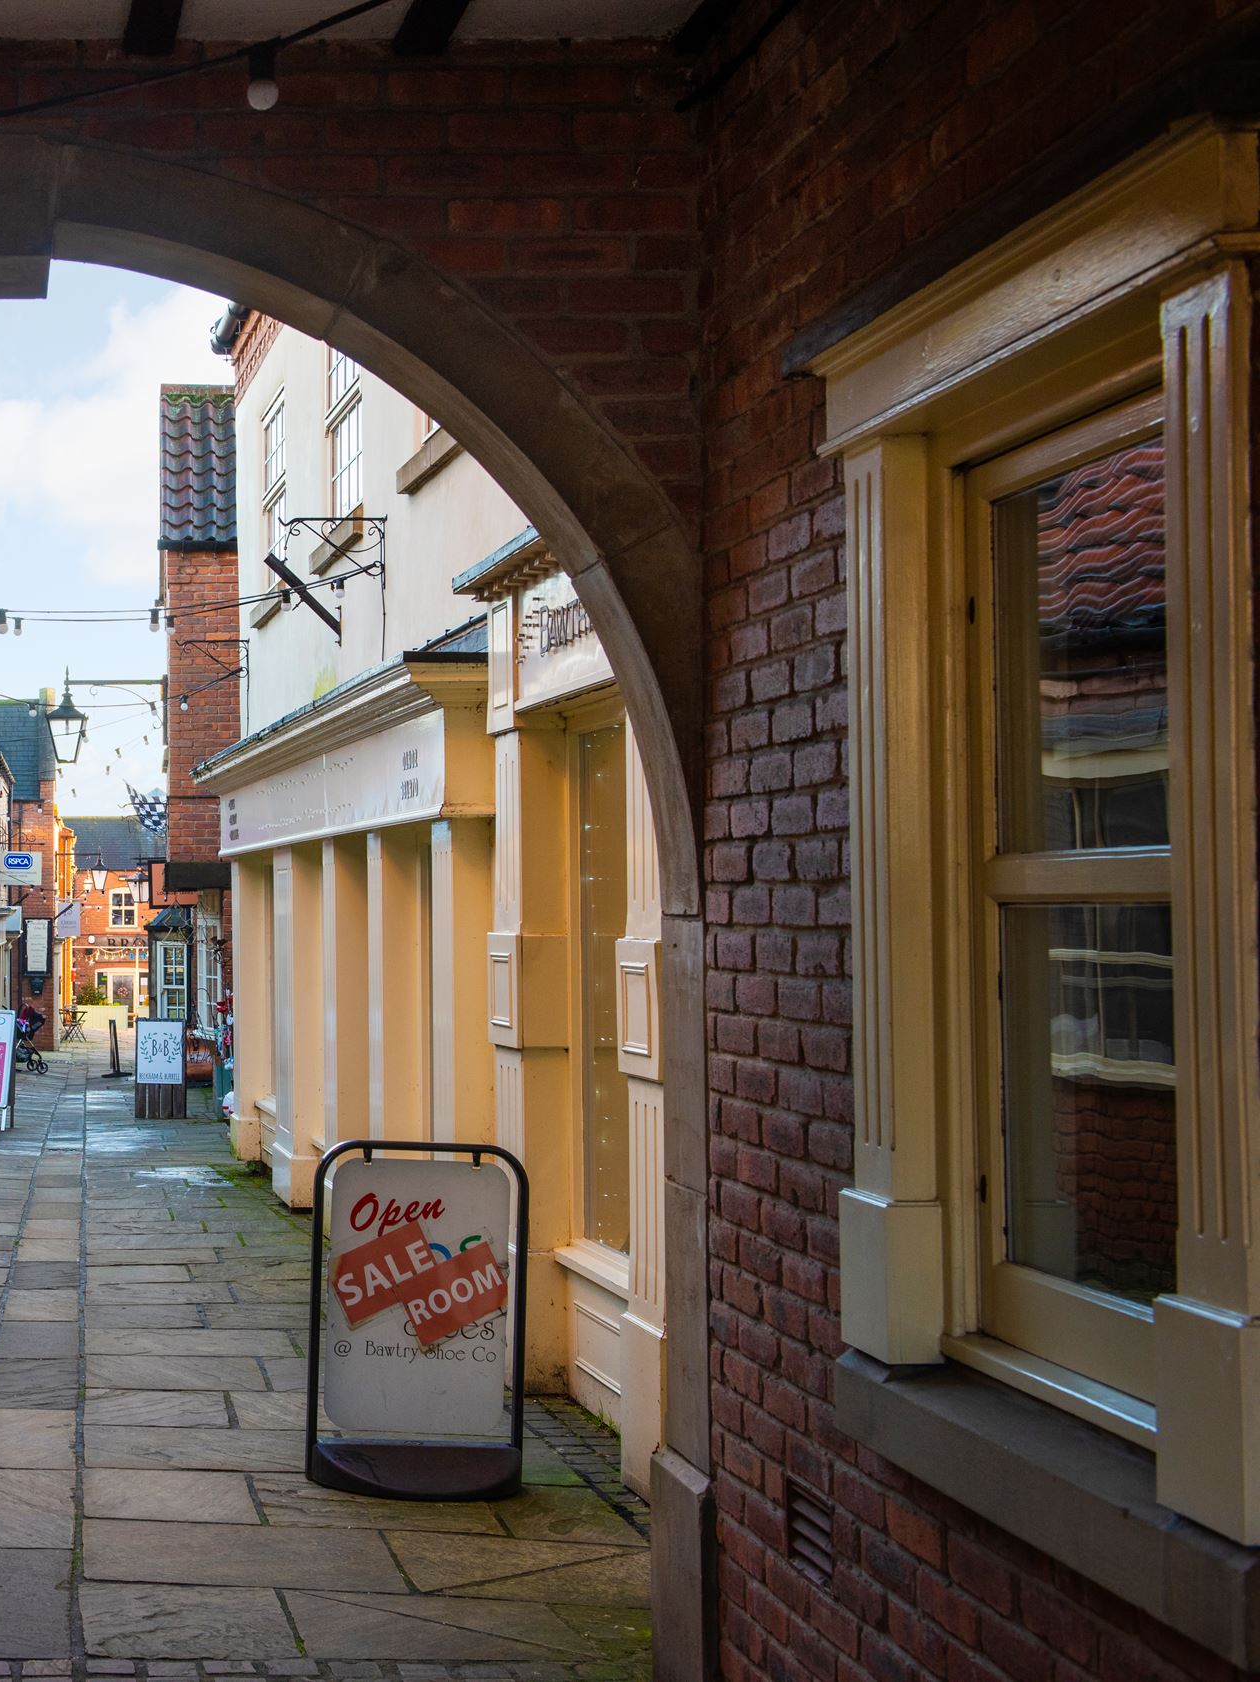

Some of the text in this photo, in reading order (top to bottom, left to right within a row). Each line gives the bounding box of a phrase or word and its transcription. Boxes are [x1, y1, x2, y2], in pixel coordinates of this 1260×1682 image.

[8, 857, 29, 865] RSPCA
[350, 1192, 445, 1237] Open
[337, 1239, 434, 1306] SALE
[407, 1263, 503, 1325] ROOM
[333, 1341, 497, 1363] @ Bawtry Shoe Co
